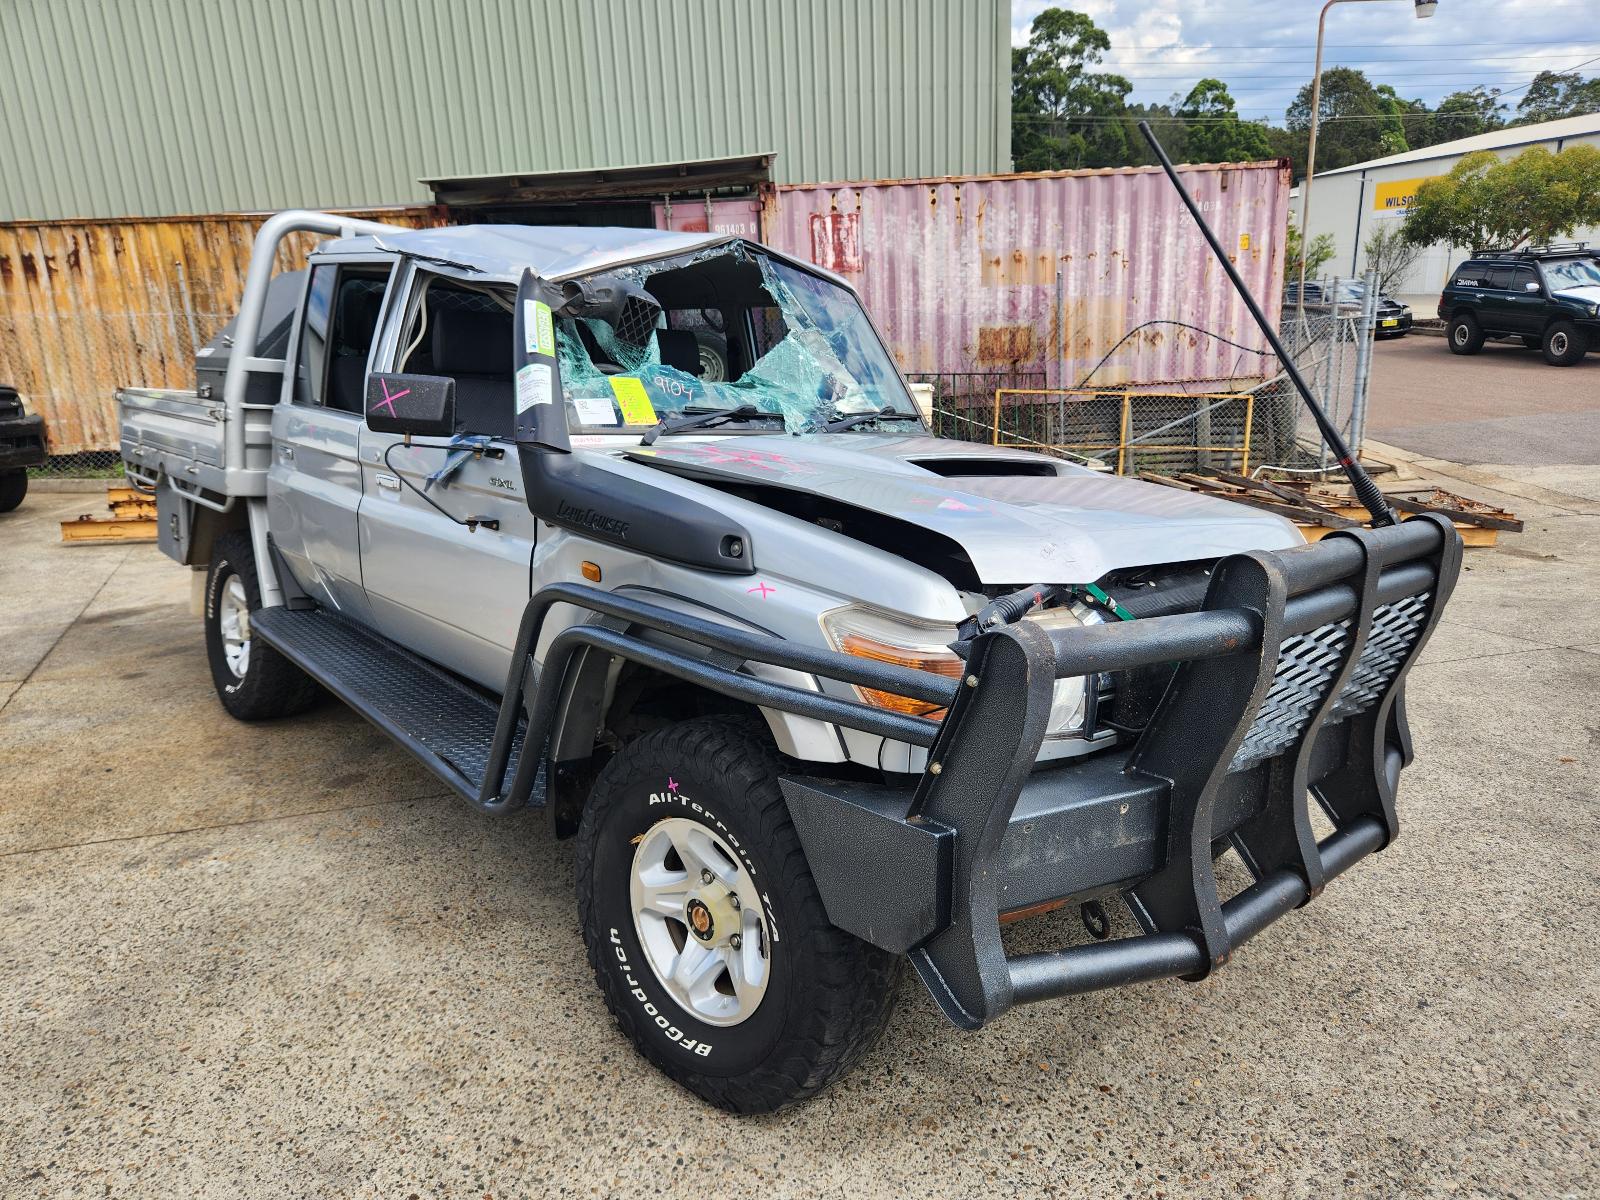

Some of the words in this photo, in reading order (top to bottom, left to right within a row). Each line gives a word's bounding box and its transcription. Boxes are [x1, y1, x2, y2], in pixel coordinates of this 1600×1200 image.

[714, 223, 746, 235] 961403
[654, 376, 693, 401] 9104
[488, 477, 517, 491] GXL
[649, 792, 757, 876] All-Terrain
[762, 891, 780, 943] T/A
[609, 927, 713, 1057] BFGoodrich
